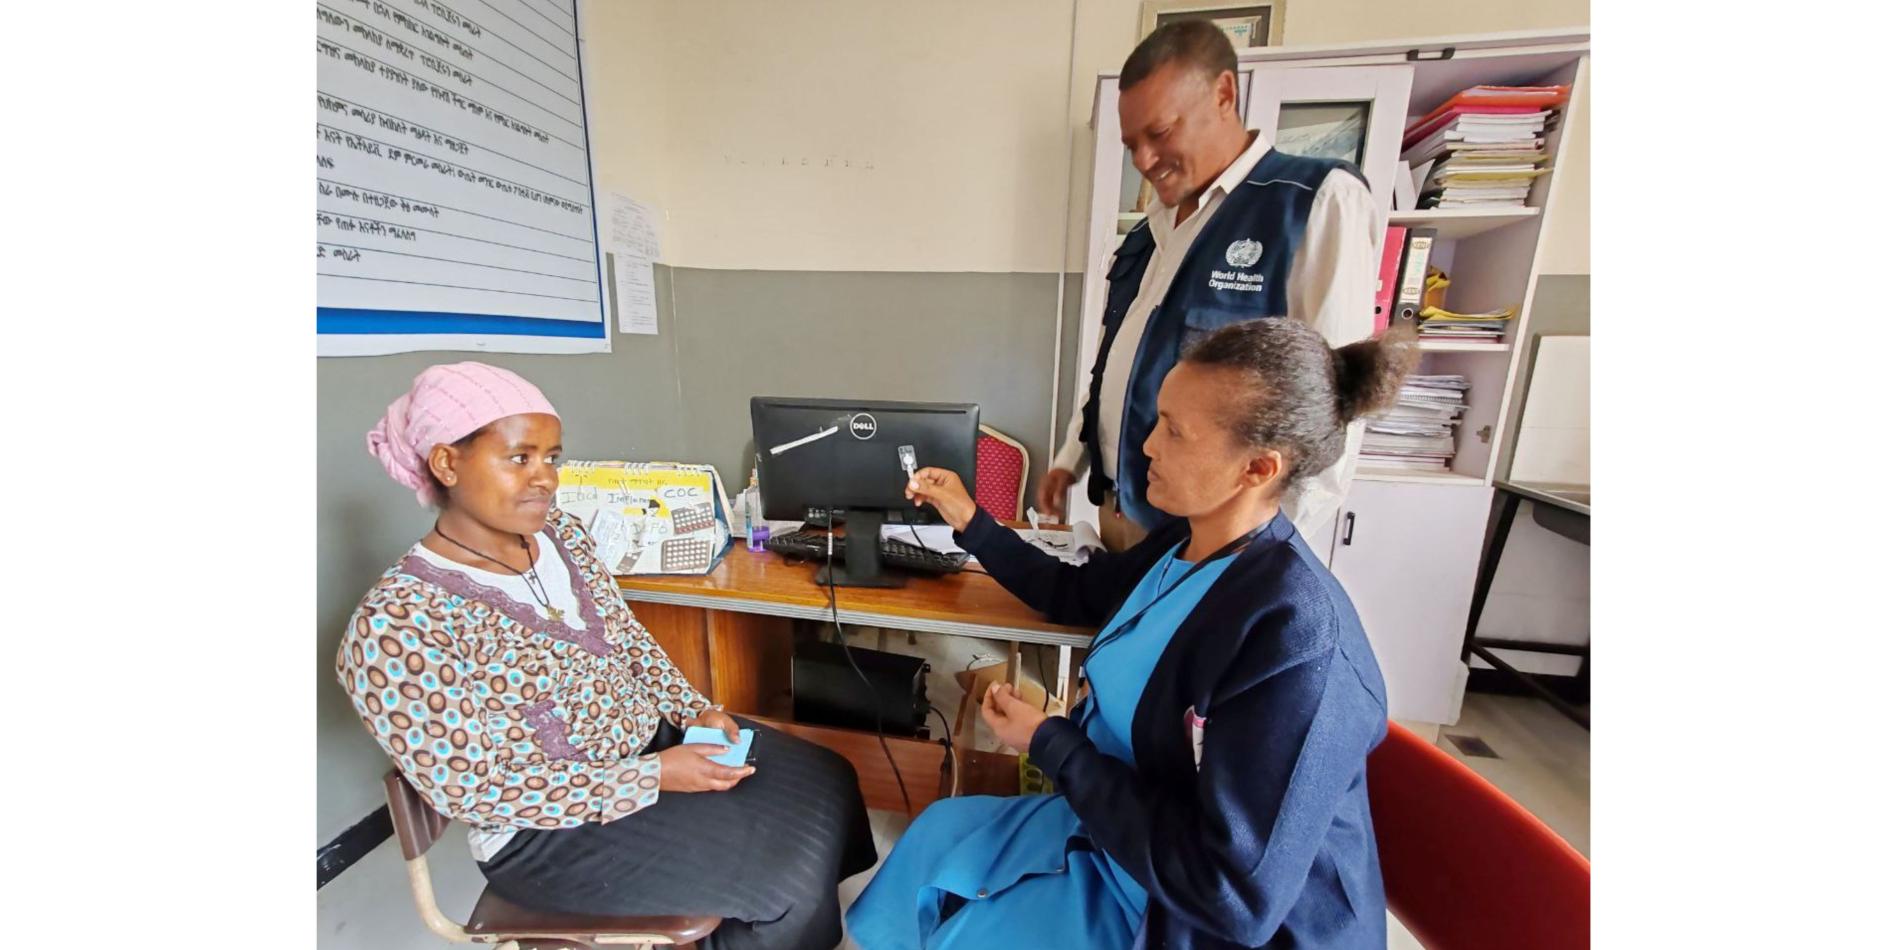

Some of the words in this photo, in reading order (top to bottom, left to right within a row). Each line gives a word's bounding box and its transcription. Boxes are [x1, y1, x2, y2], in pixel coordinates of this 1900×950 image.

[1211, 270, 1236, 280] World
[1237, 272, 1264, 282] Health
[1208, 279, 1262, 292] Organization
[853, 422, 873, 430] DELL
[664, 487, 698, 499] COC
